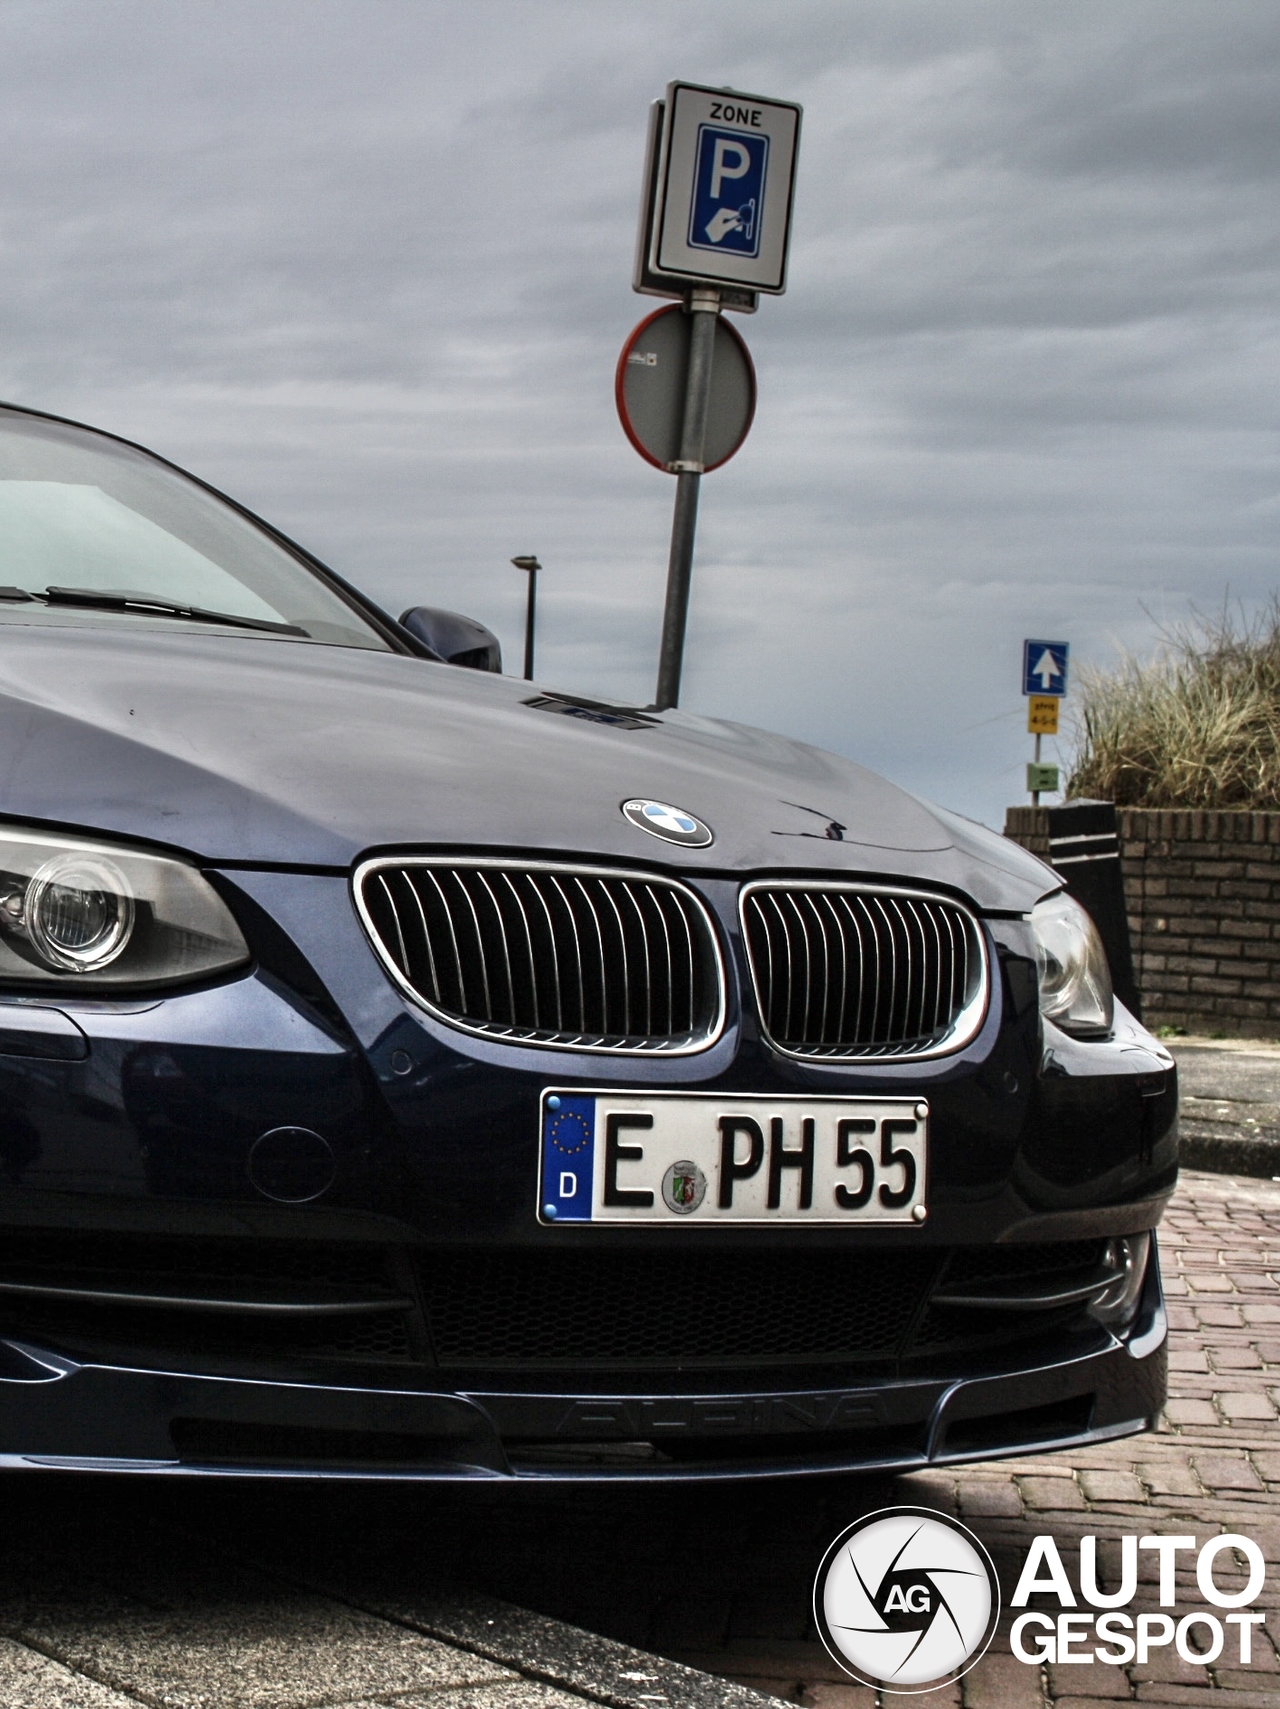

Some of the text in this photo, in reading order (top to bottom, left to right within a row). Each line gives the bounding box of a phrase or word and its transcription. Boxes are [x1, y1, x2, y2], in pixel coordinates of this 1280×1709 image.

[710, 102, 762, 127] ZONE
[710, 138, 751, 199] P
[603, 1113, 918, 1209] E PH 55
[559, 1172, 577, 1198] D
